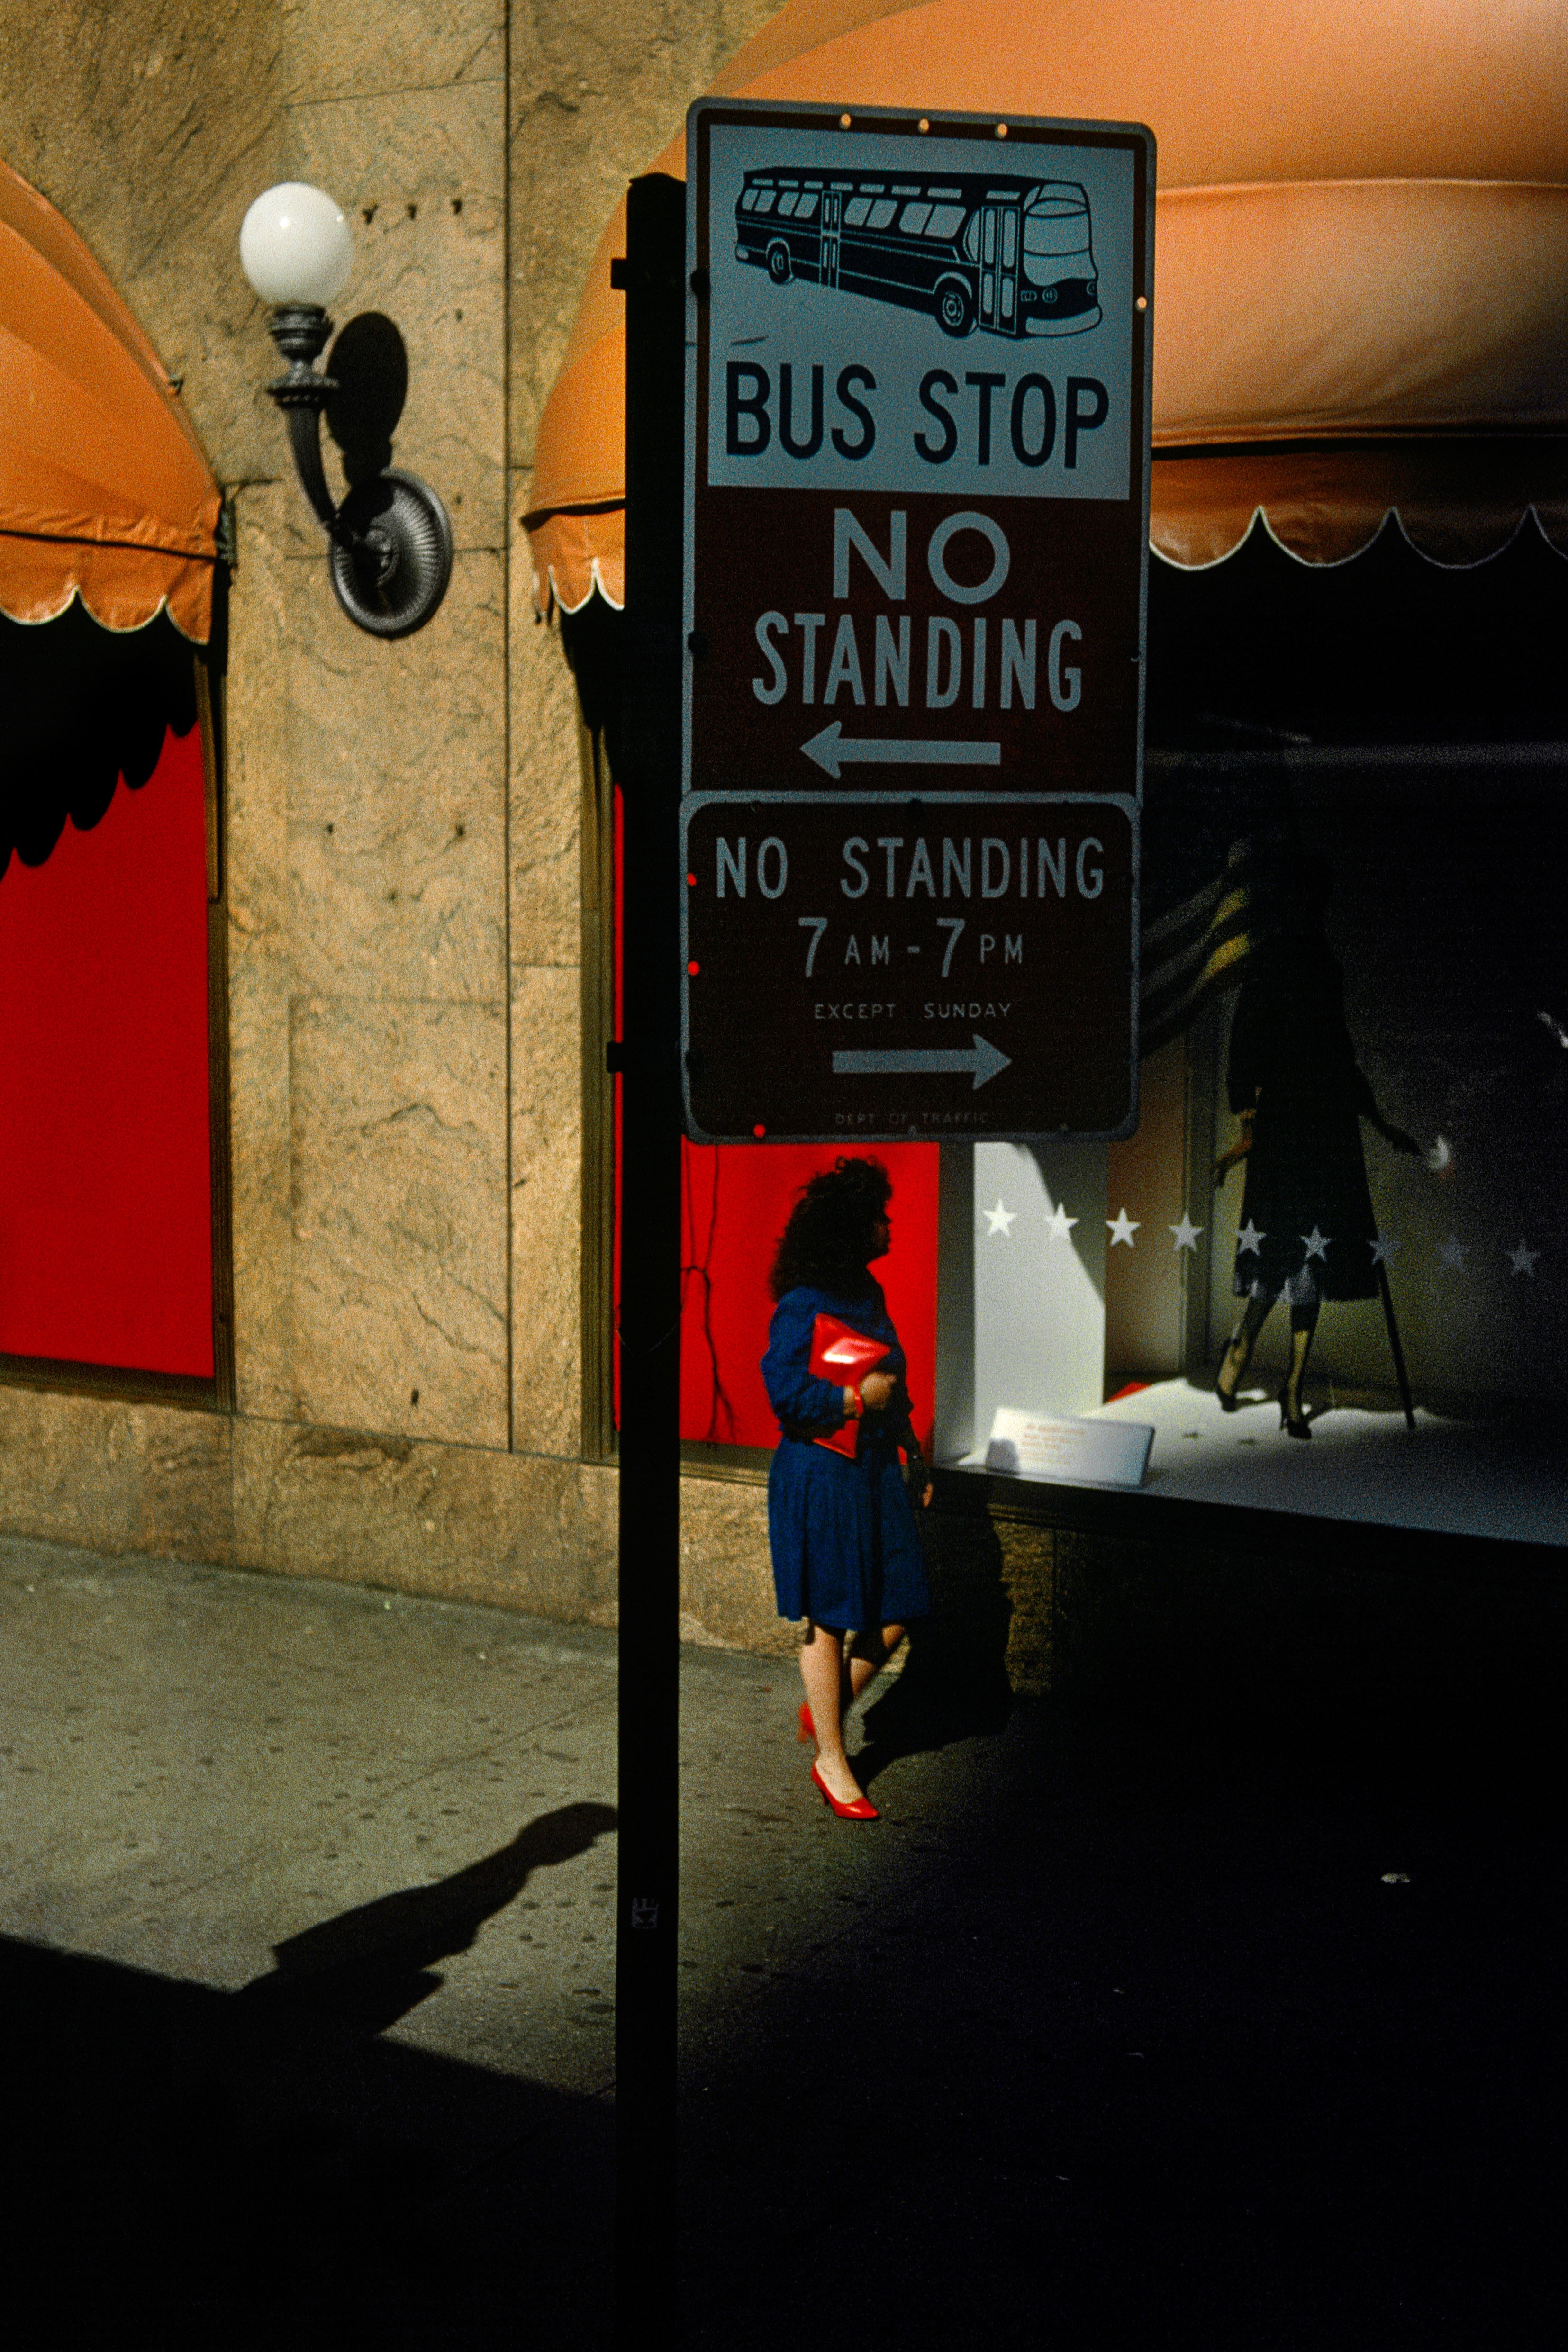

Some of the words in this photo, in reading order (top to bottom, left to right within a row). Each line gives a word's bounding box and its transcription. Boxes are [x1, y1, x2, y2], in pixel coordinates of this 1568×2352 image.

[726, 361, 877, 461] BUS
[914, 368, 1109, 469] STOP
[833, 507, 1011, 605] NO
[752, 610, 1083, 712] STANDING
[716, 836, 788, 899] NO
[840, 836, 1104, 900] STANDING
[797, 916, 828, 977] 7
[843, 934, 890, 965] AM
[936, 917, 966, 978] 7
[979, 933, 1024, 964] PM
[814, 1002, 896, 1021] EXCEPT
[924, 1002, 1012, 1020] SUNDAY
[834, 1112, 875, 1125] DEPT
[888, 1112, 908, 1125] OF
[921, 1112, 988, 1124] TRAFFIC
